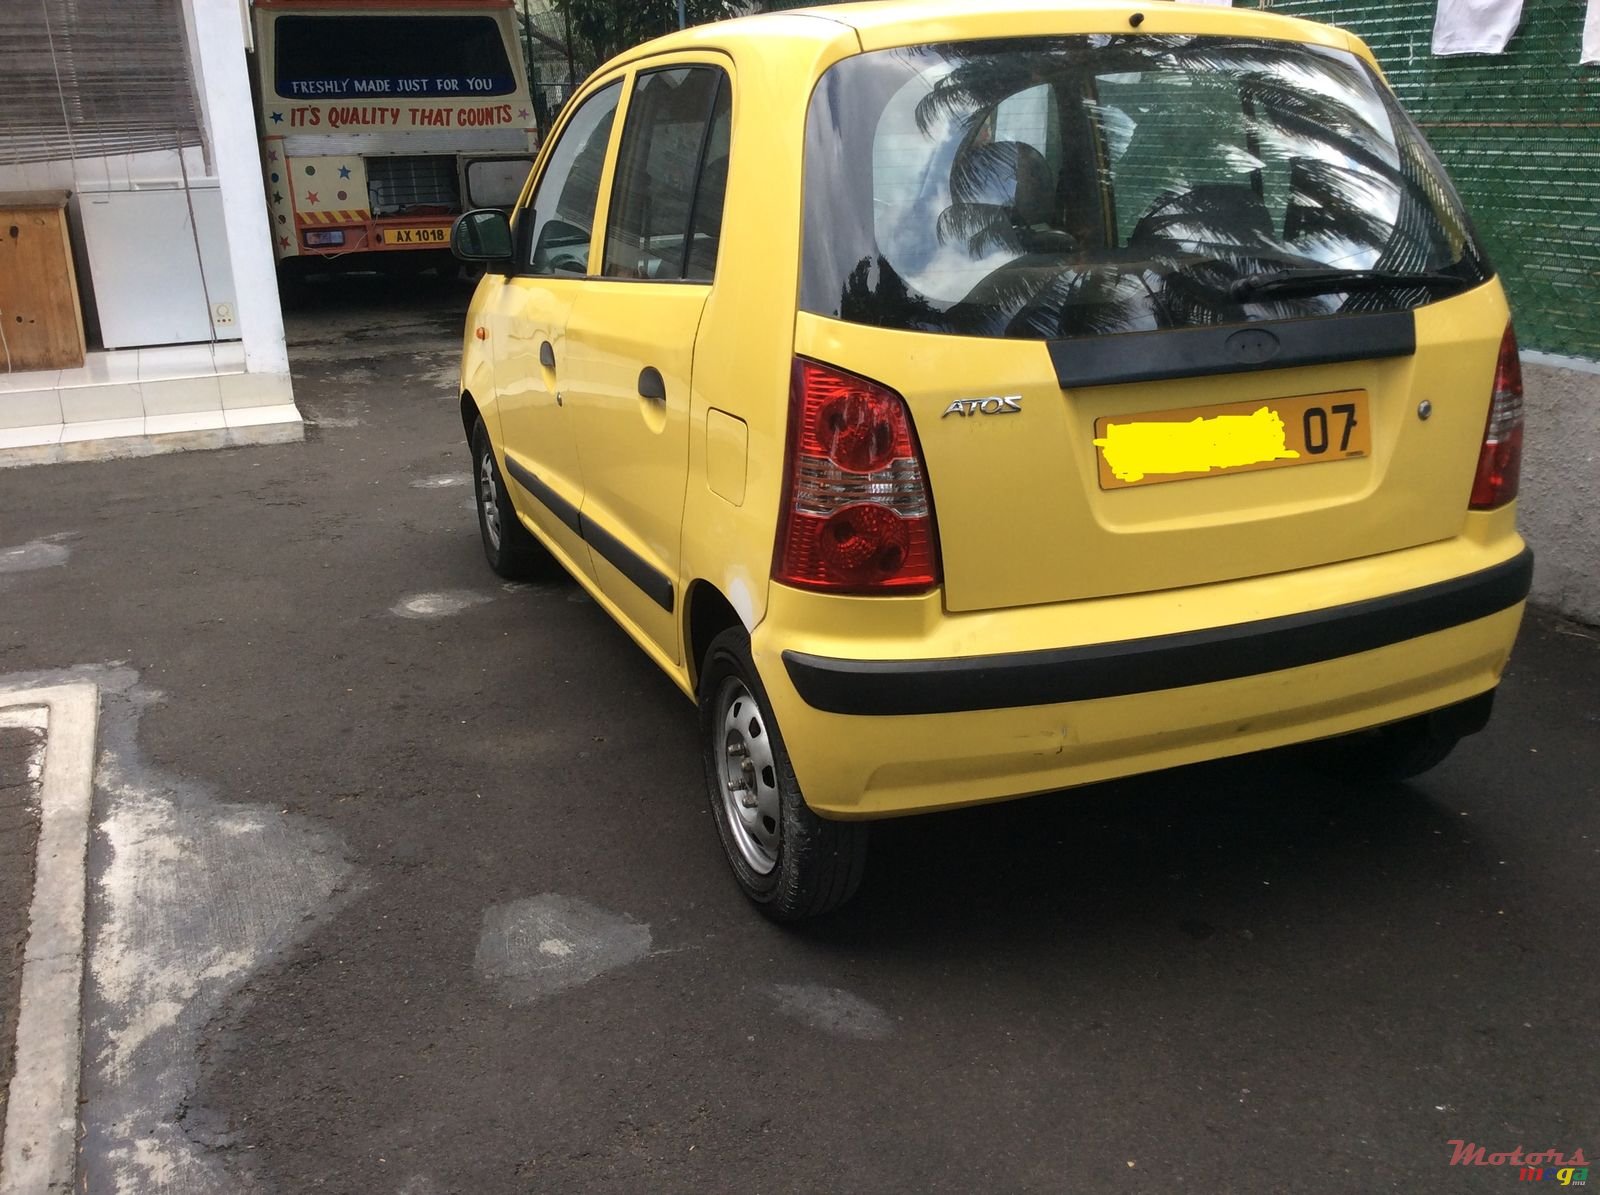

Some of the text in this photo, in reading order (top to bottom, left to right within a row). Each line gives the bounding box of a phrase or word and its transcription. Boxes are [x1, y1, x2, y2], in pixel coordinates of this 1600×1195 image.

[292, 77, 493, 94] FRESHLY MADE JUST FOR YOU
[290, 104, 513, 127] IT'S QUALITY THAT COUNTS
[396, 229, 445, 242] AX 1018
[940, 395, 1022, 419] ATOS
[1303, 403, 1357, 454] 07
